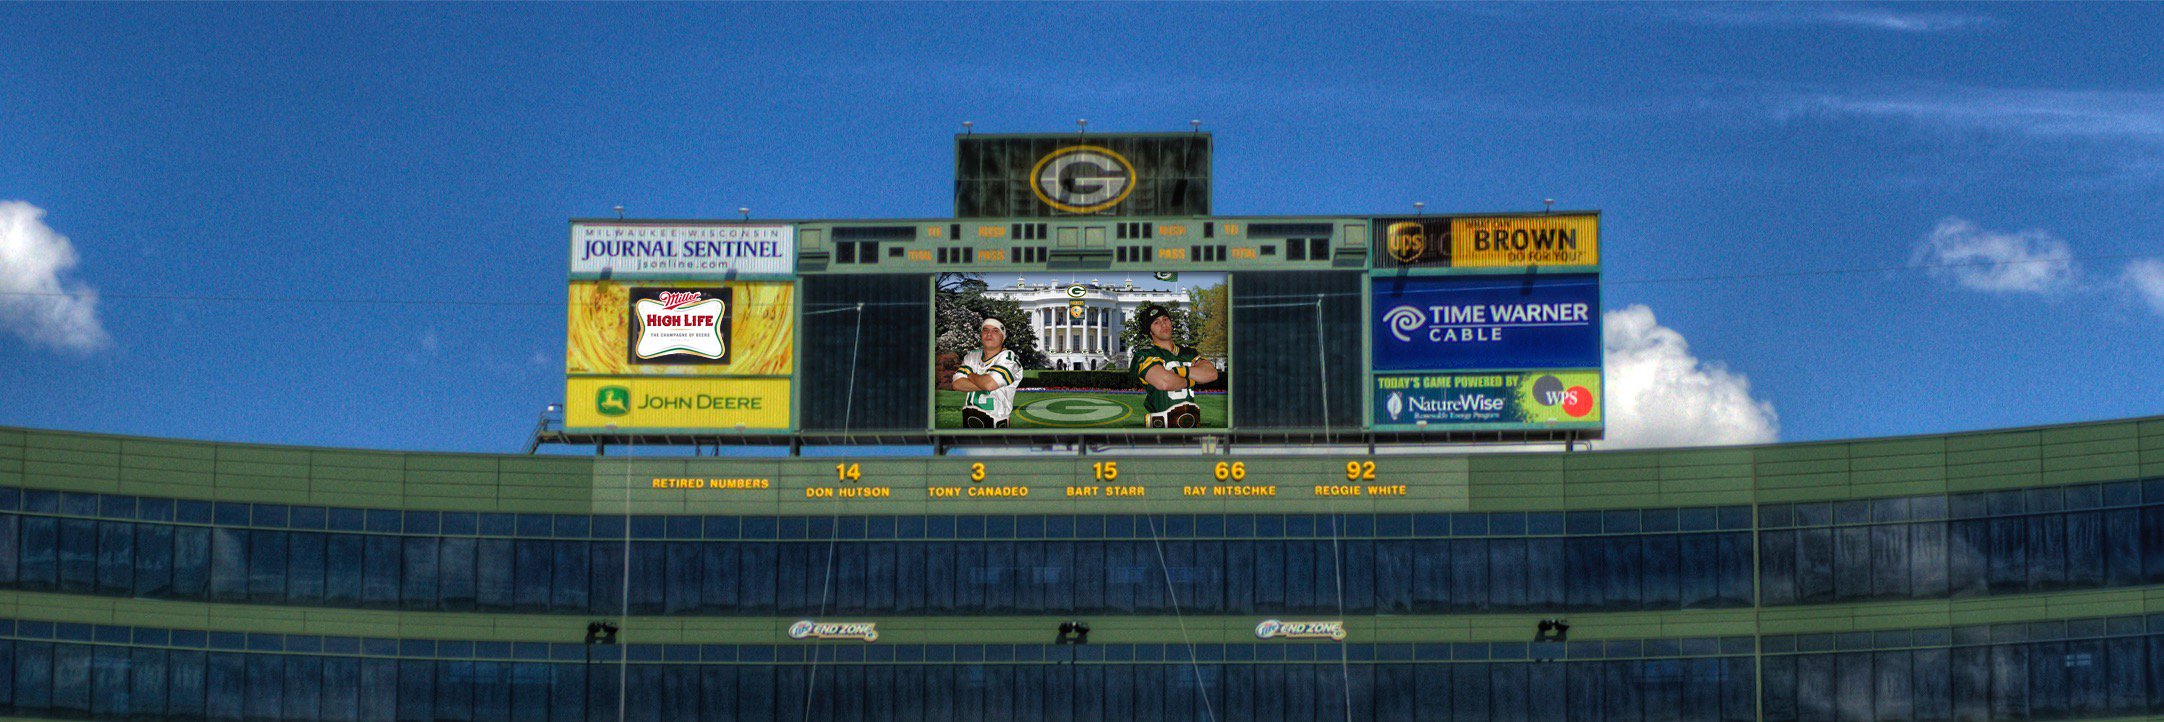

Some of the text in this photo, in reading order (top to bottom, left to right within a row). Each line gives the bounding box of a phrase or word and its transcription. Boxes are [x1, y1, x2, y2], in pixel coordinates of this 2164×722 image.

[1158, 224, 1186, 236] RUSH
[1224, 223, 1239, 235] TO
[1474, 228, 1577, 251] BROWN
[582, 240, 783, 261] JOURNAL SENTINEL
[978, 249, 1005, 261] PASS
[1158, 247, 1186, 259] PASS
[1231, 247, 1256, 259] TOTAL
[637, 258, 728, 270] jsonline.com
[660, 291, 701, 307] Miller
[1429, 303, 1588, 323] TIME WARNER
[647, 314, 713, 326] HIGH LIFE
[1429, 327, 1502, 342] CABLE
[1378, 376, 1519, 389] TODAY'S GAME POWERED BY
[638, 394, 762, 409] JOHN DEERE
[1408, 394, 1503, 411] NatureWise
[1546, 391, 1578, 405] WPS
[836, 463, 861, 481] 14
[971, 463, 985, 481] 3
[1093, 462, 1117, 480] 15
[1214, 461, 1245, 480] 66
[1346, 461, 1376, 480] 92
[652, 478, 769, 488] RETIRED NUMBERS
[806, 487, 890, 497] DON HUTSON
[928, 486, 1028, 497] TONY CANADEO
[1066, 486, 1145, 496] BART STARR
[1184, 485, 1276, 496] RAY NITSCHKE
[1314, 485, 1407, 496] REGGIE WHITE
